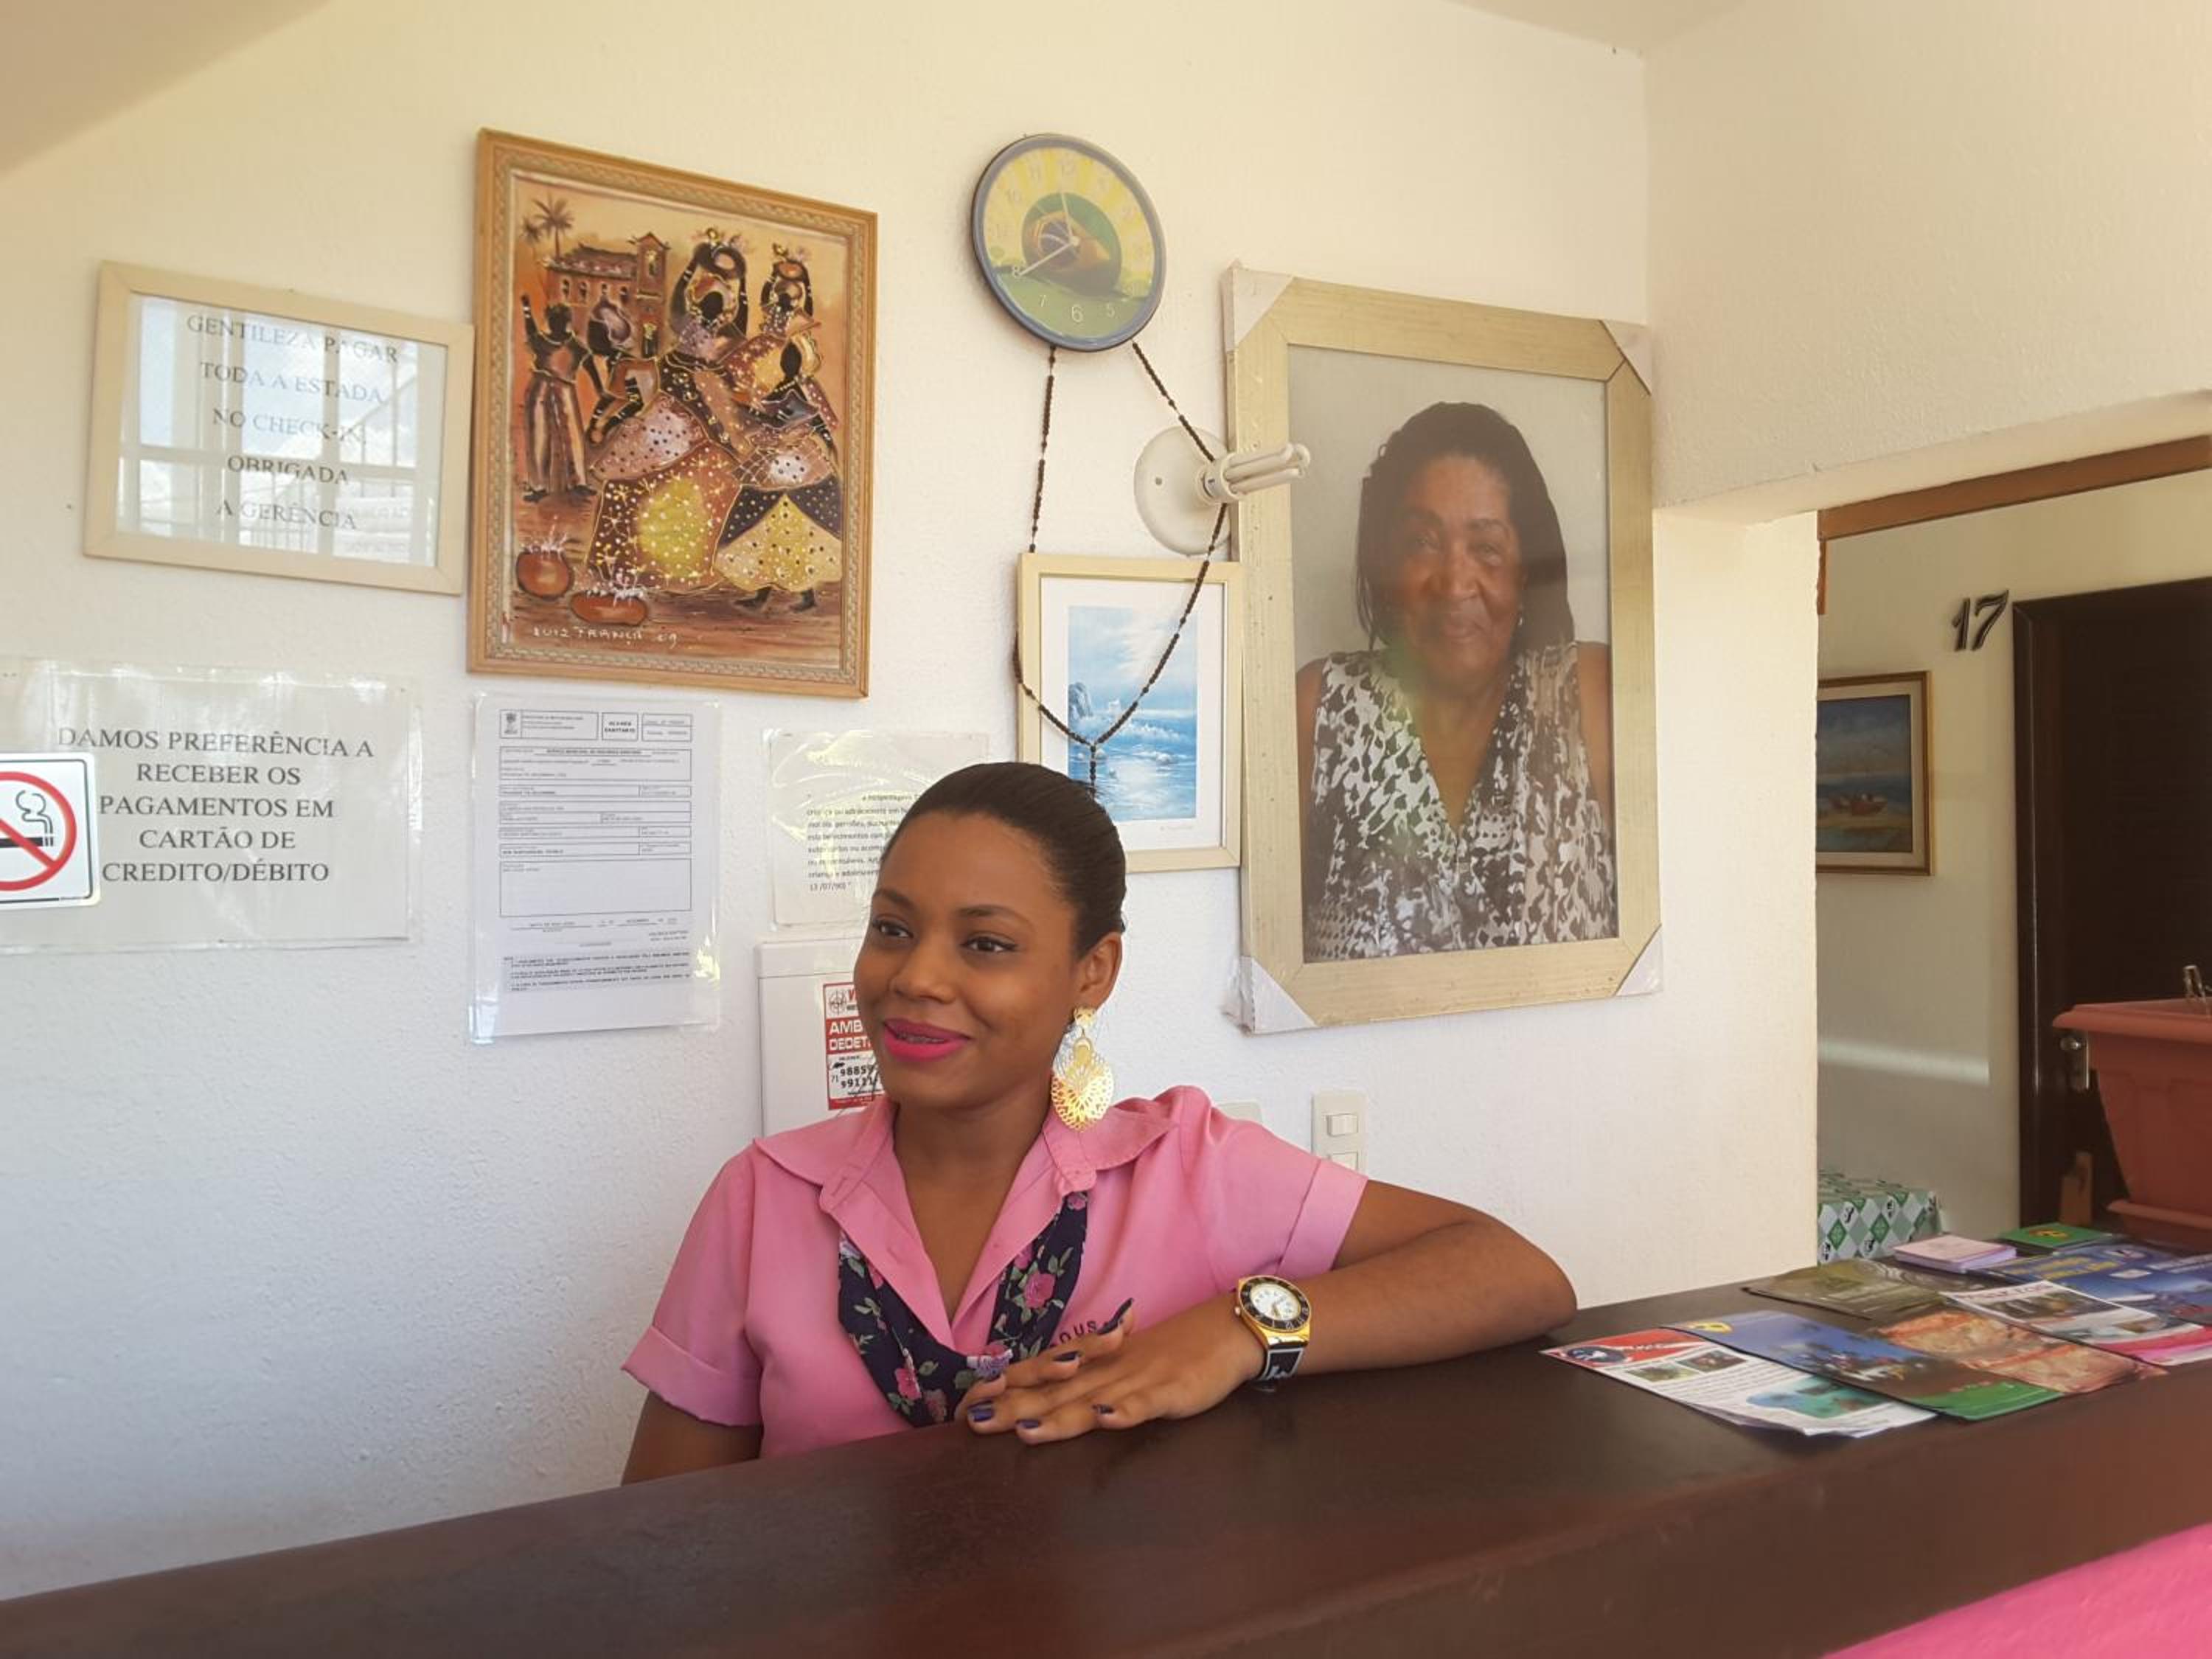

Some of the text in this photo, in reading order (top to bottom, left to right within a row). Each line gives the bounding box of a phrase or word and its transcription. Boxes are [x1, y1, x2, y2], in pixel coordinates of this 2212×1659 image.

[187, 315, 317, 350] GENTILEZA
[200, 361, 386, 405] TODA A ESTADA
[213, 408, 246, 428] NO
[227, 454, 349, 485] OBRIGADA
[216, 499, 234, 516] A
[1952, 589, 2008, 652] 17
[58, 728, 375, 758] DAMOS PREFERÊNCIA A
[136, 763, 301, 786] RECEBER OS
[100, 795, 335, 818] PAGAMENTOS EM
[139, 826, 296, 849] CARTÃO DE
[102, 859, 330, 883] CREDITO/DÉBITO
